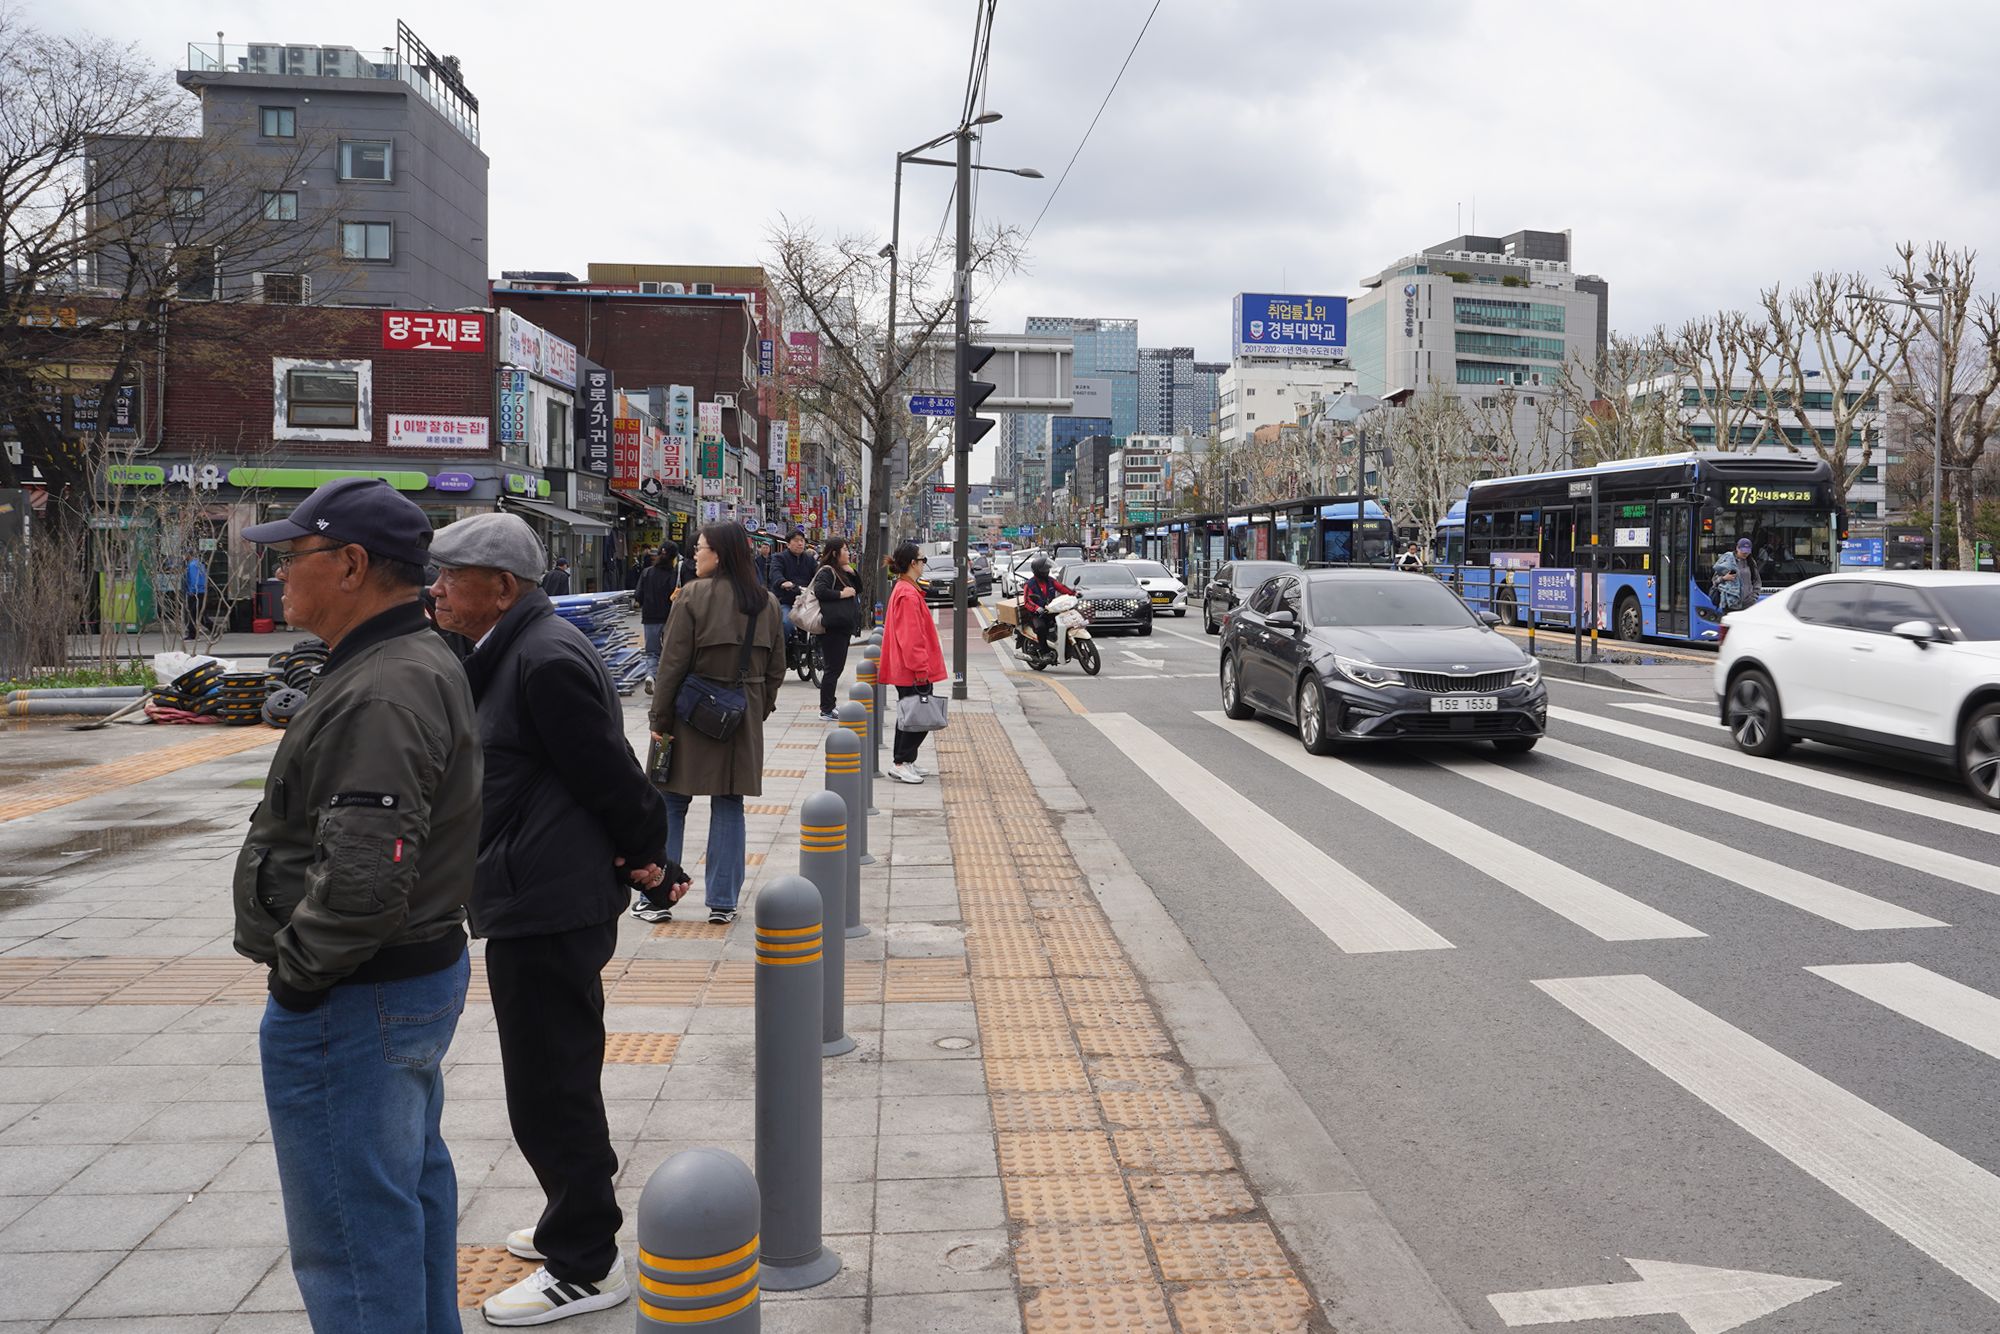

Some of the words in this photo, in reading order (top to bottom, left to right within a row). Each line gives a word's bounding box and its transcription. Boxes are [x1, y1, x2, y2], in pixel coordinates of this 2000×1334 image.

[388, 316, 482, 342] 당구재료
[1268, 322, 1336, 341] 경복대학교
[514, 372, 524, 392] 이발
[928, 397, 955, 408] 종로26
[662, 436, 683, 446] 삼성
[664, 445, 681, 479] 의료기
[113, 470, 141, 480] Nice
[144, 469, 157, 480] to
[169, 464, 225, 489] 씨유
[705, 480, 720, 490] 국수
[1730, 487, 1757, 504] 273
[1757, 491, 1780, 501] 신내동
[1465, 698, 1493, 710] 1536
